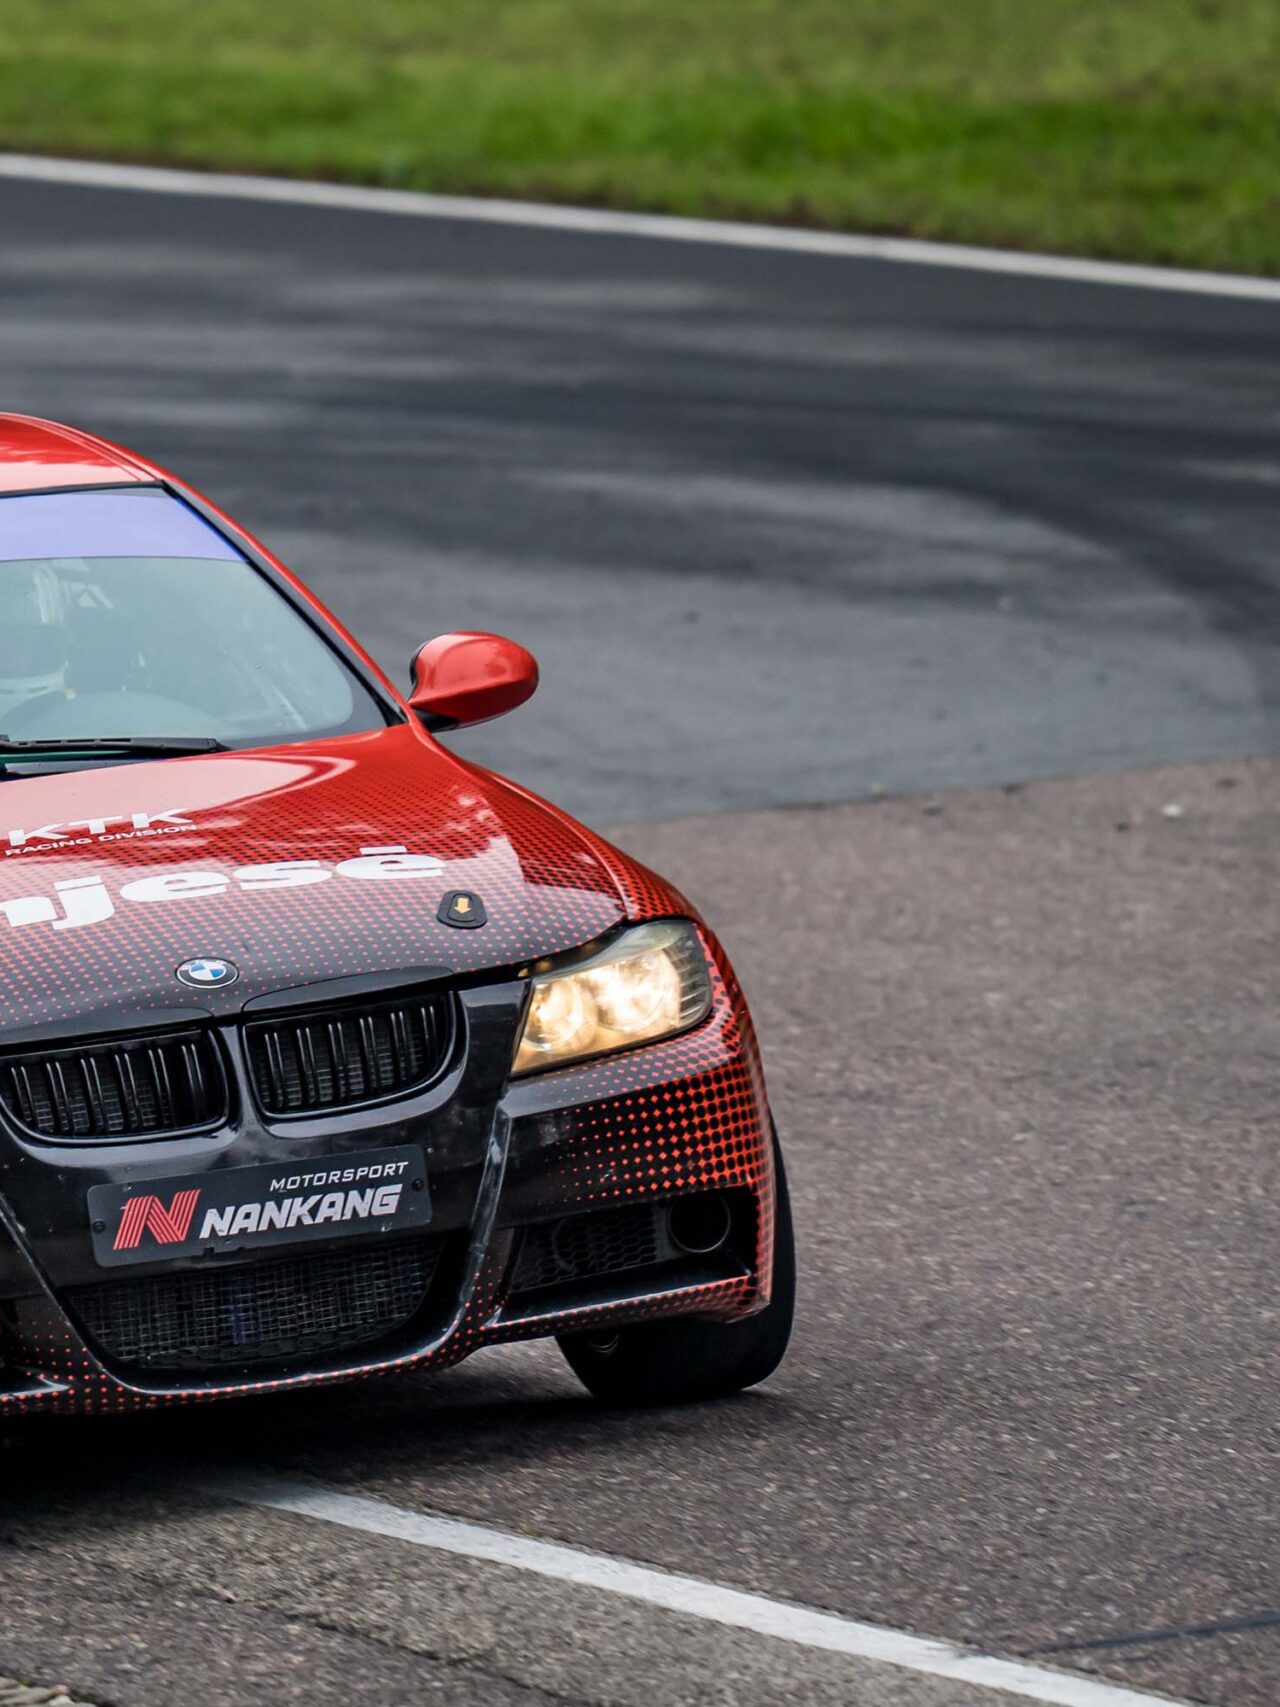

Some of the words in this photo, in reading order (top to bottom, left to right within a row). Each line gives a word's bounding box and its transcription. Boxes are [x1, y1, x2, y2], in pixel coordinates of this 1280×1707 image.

[5, 837, 92, 856] RACING
[98, 824, 198, 842] DIVISION
[9, 808, 193, 847] KTK
[268, 1161, 409, 1193] MOTORSPORT
[198, 1183, 405, 1239] NANKANG
